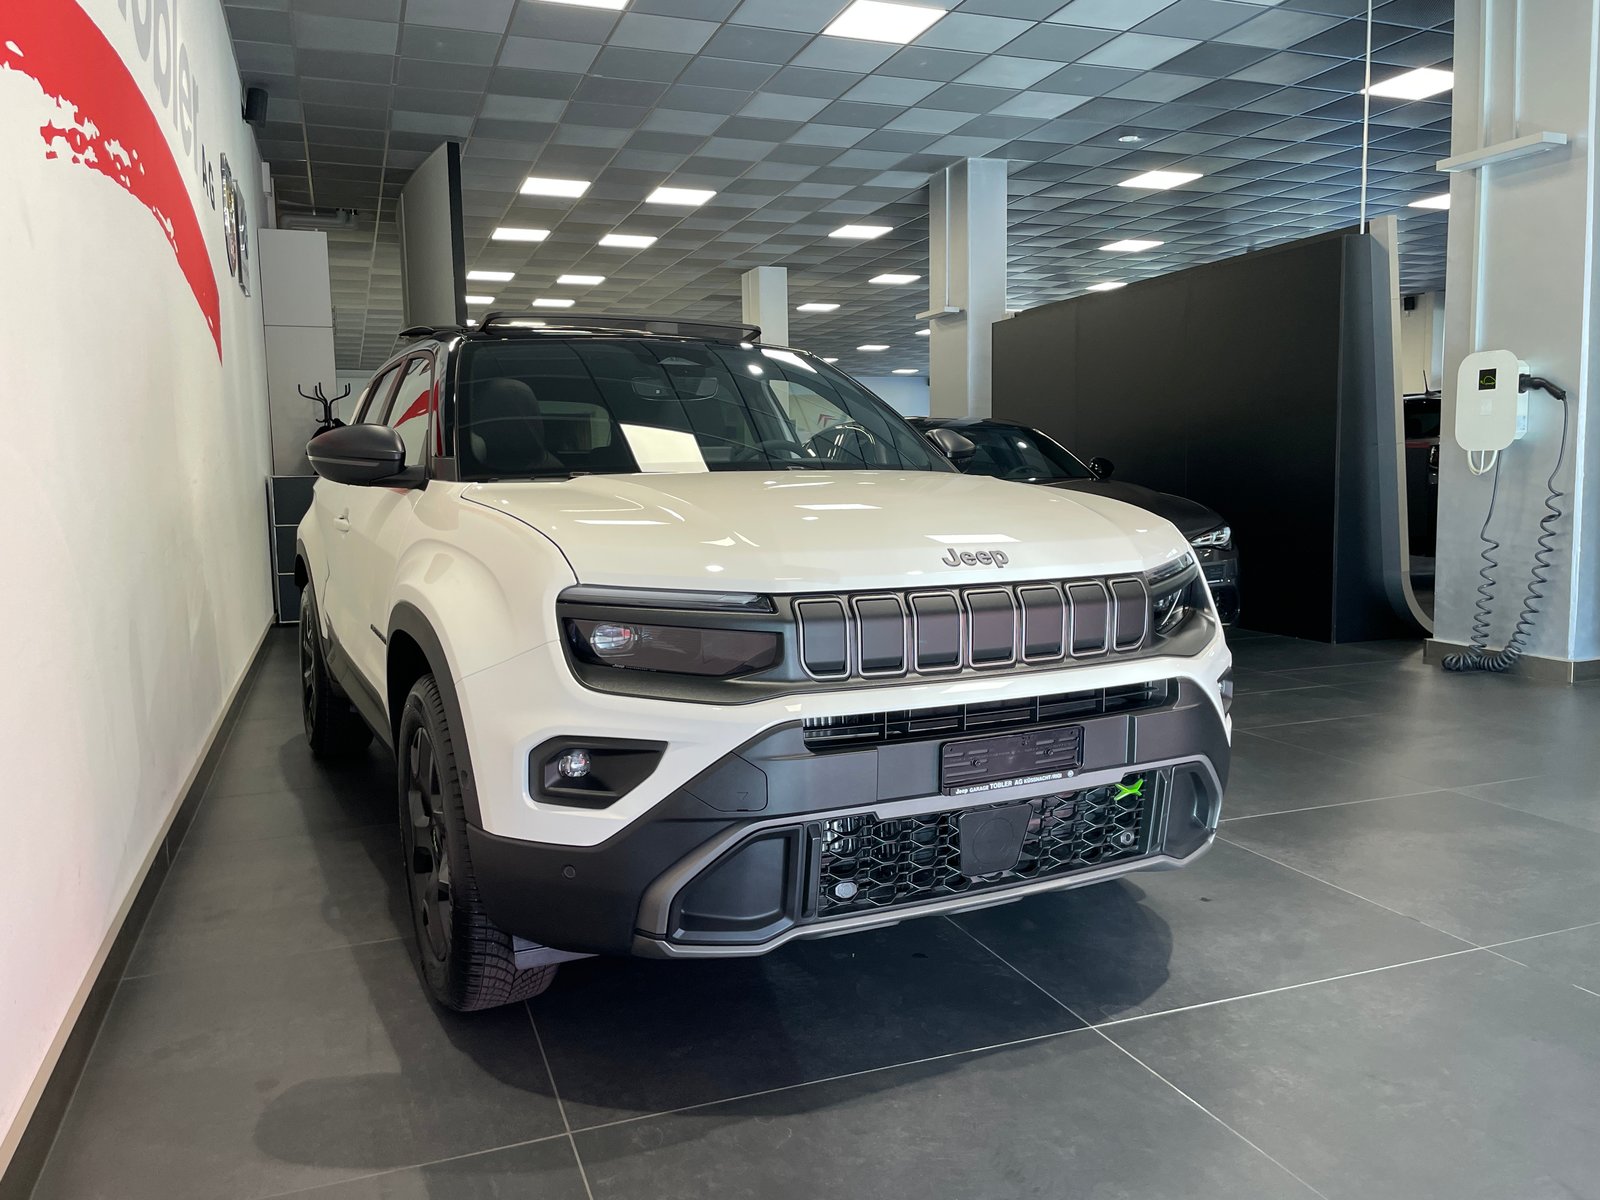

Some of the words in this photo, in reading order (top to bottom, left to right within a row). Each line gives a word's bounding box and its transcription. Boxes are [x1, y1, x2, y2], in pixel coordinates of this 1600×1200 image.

[117, 0, 198, 175] bler
[201, 144, 215, 211] AG
[941, 548, 1009, 568] Jeep
[990, 780, 1012, 789] TOBLER
